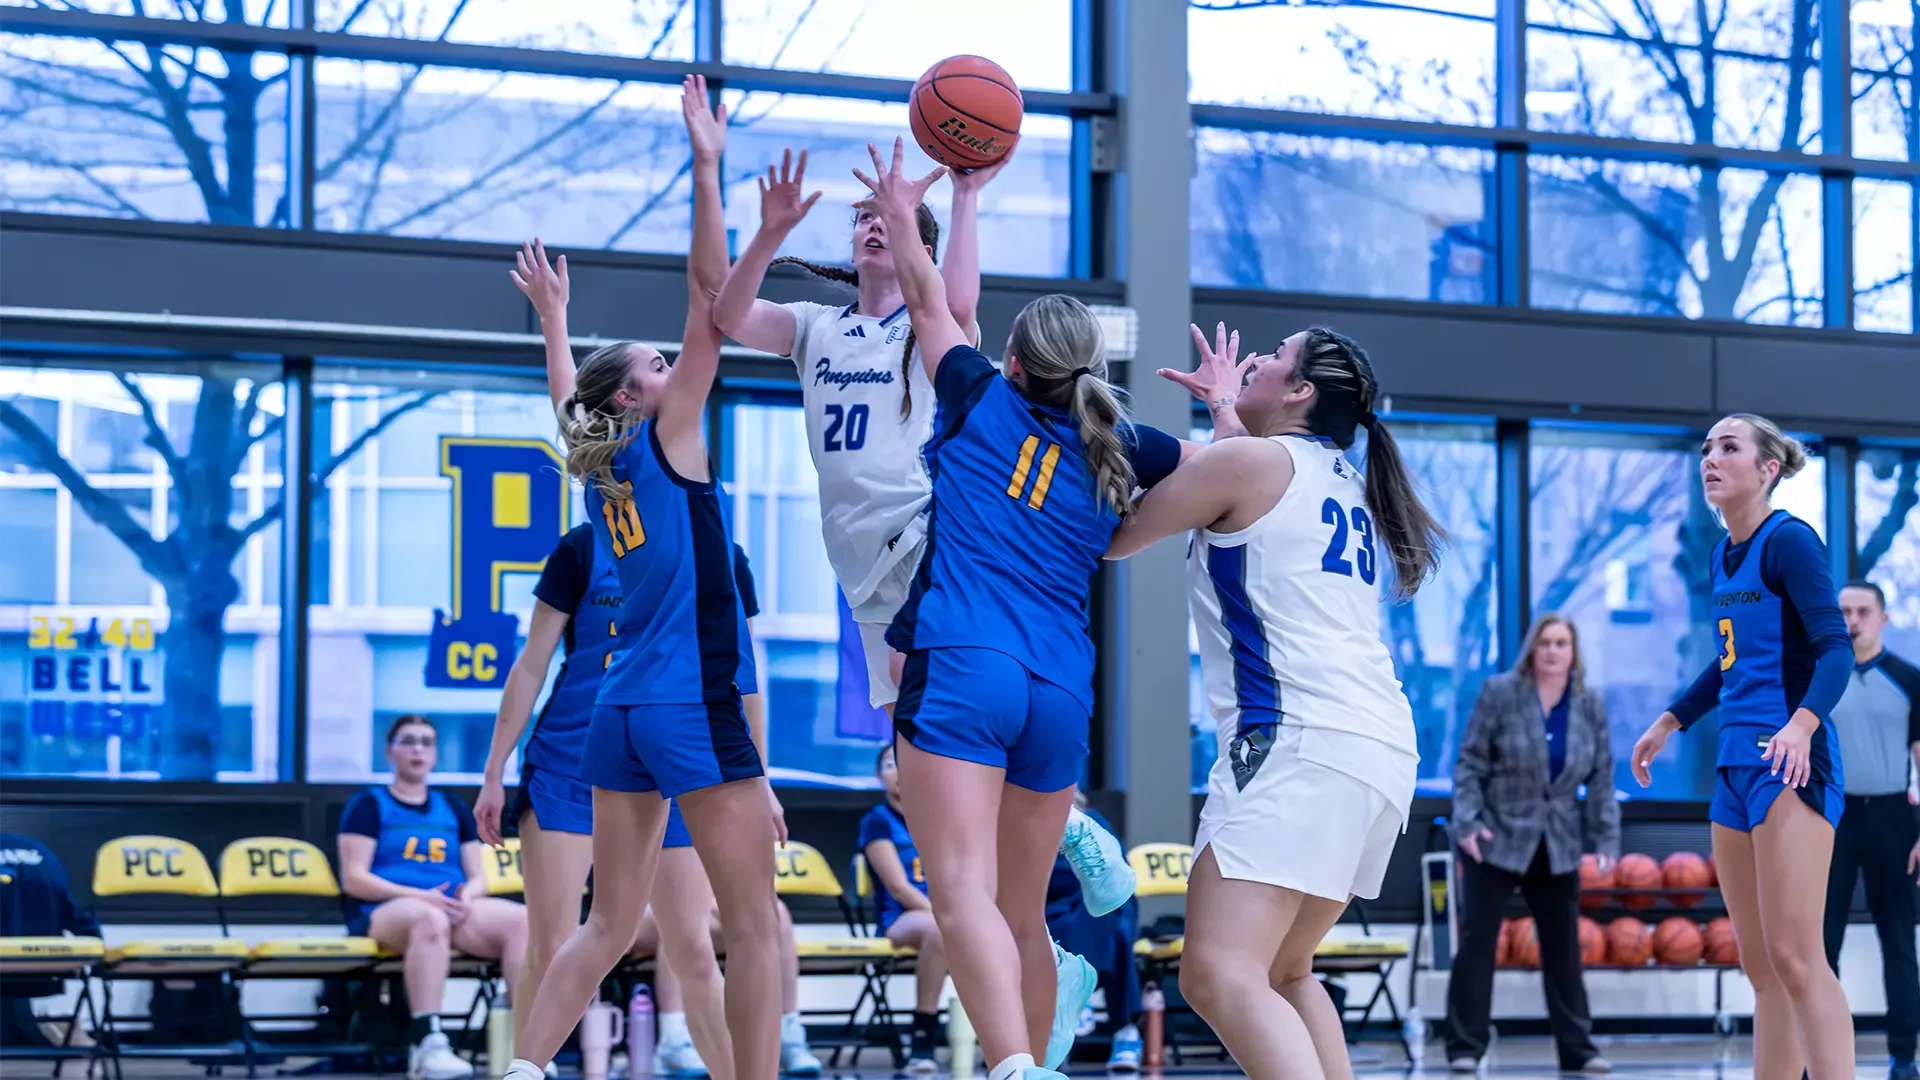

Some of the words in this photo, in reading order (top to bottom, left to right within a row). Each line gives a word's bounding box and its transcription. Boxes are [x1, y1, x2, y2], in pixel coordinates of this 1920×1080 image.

[813, 357, 894, 392] Penguins
[824, 404, 869, 452] 20
[1006, 433, 1061, 512] 11
[440, 436, 572, 620] P
[603, 480, 646, 559] 10
[1321, 497, 1376, 586] 23
[447, 641, 498, 682] CC
[1718, 617, 1736, 672] 3
[33, 657, 151, 692] BELL
[31, 701, 152, 738] WEST
[122, 847, 183, 876] PCC
[248, 848, 308, 877] PCC
[1146, 852, 1191, 879] PCC
